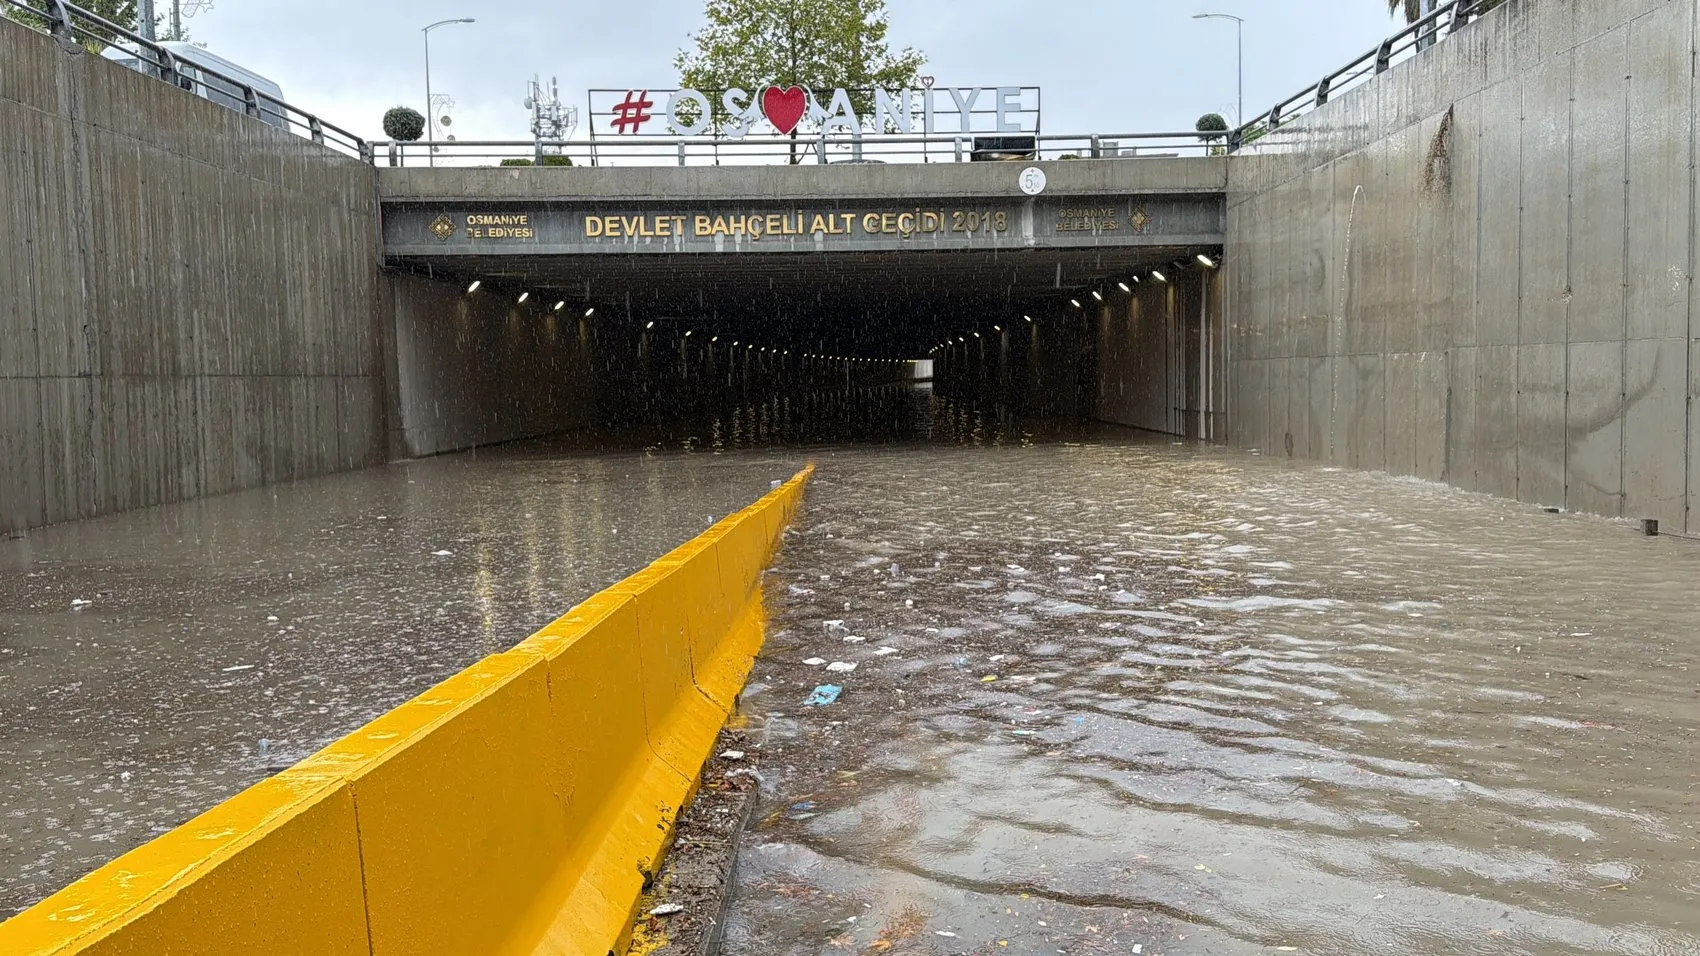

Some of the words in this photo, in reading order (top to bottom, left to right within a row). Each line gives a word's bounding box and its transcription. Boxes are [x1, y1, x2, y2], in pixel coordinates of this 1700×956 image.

[466, 214, 528, 225] OSMANİYE
[585, 215, 687, 237] DEVLET
[694, 209, 804, 240] BAHÇELİ
[810, 213, 856, 234] ALT
[862, 207, 945, 238] GEÇİDİ
[951, 210, 1007, 232] 2018
